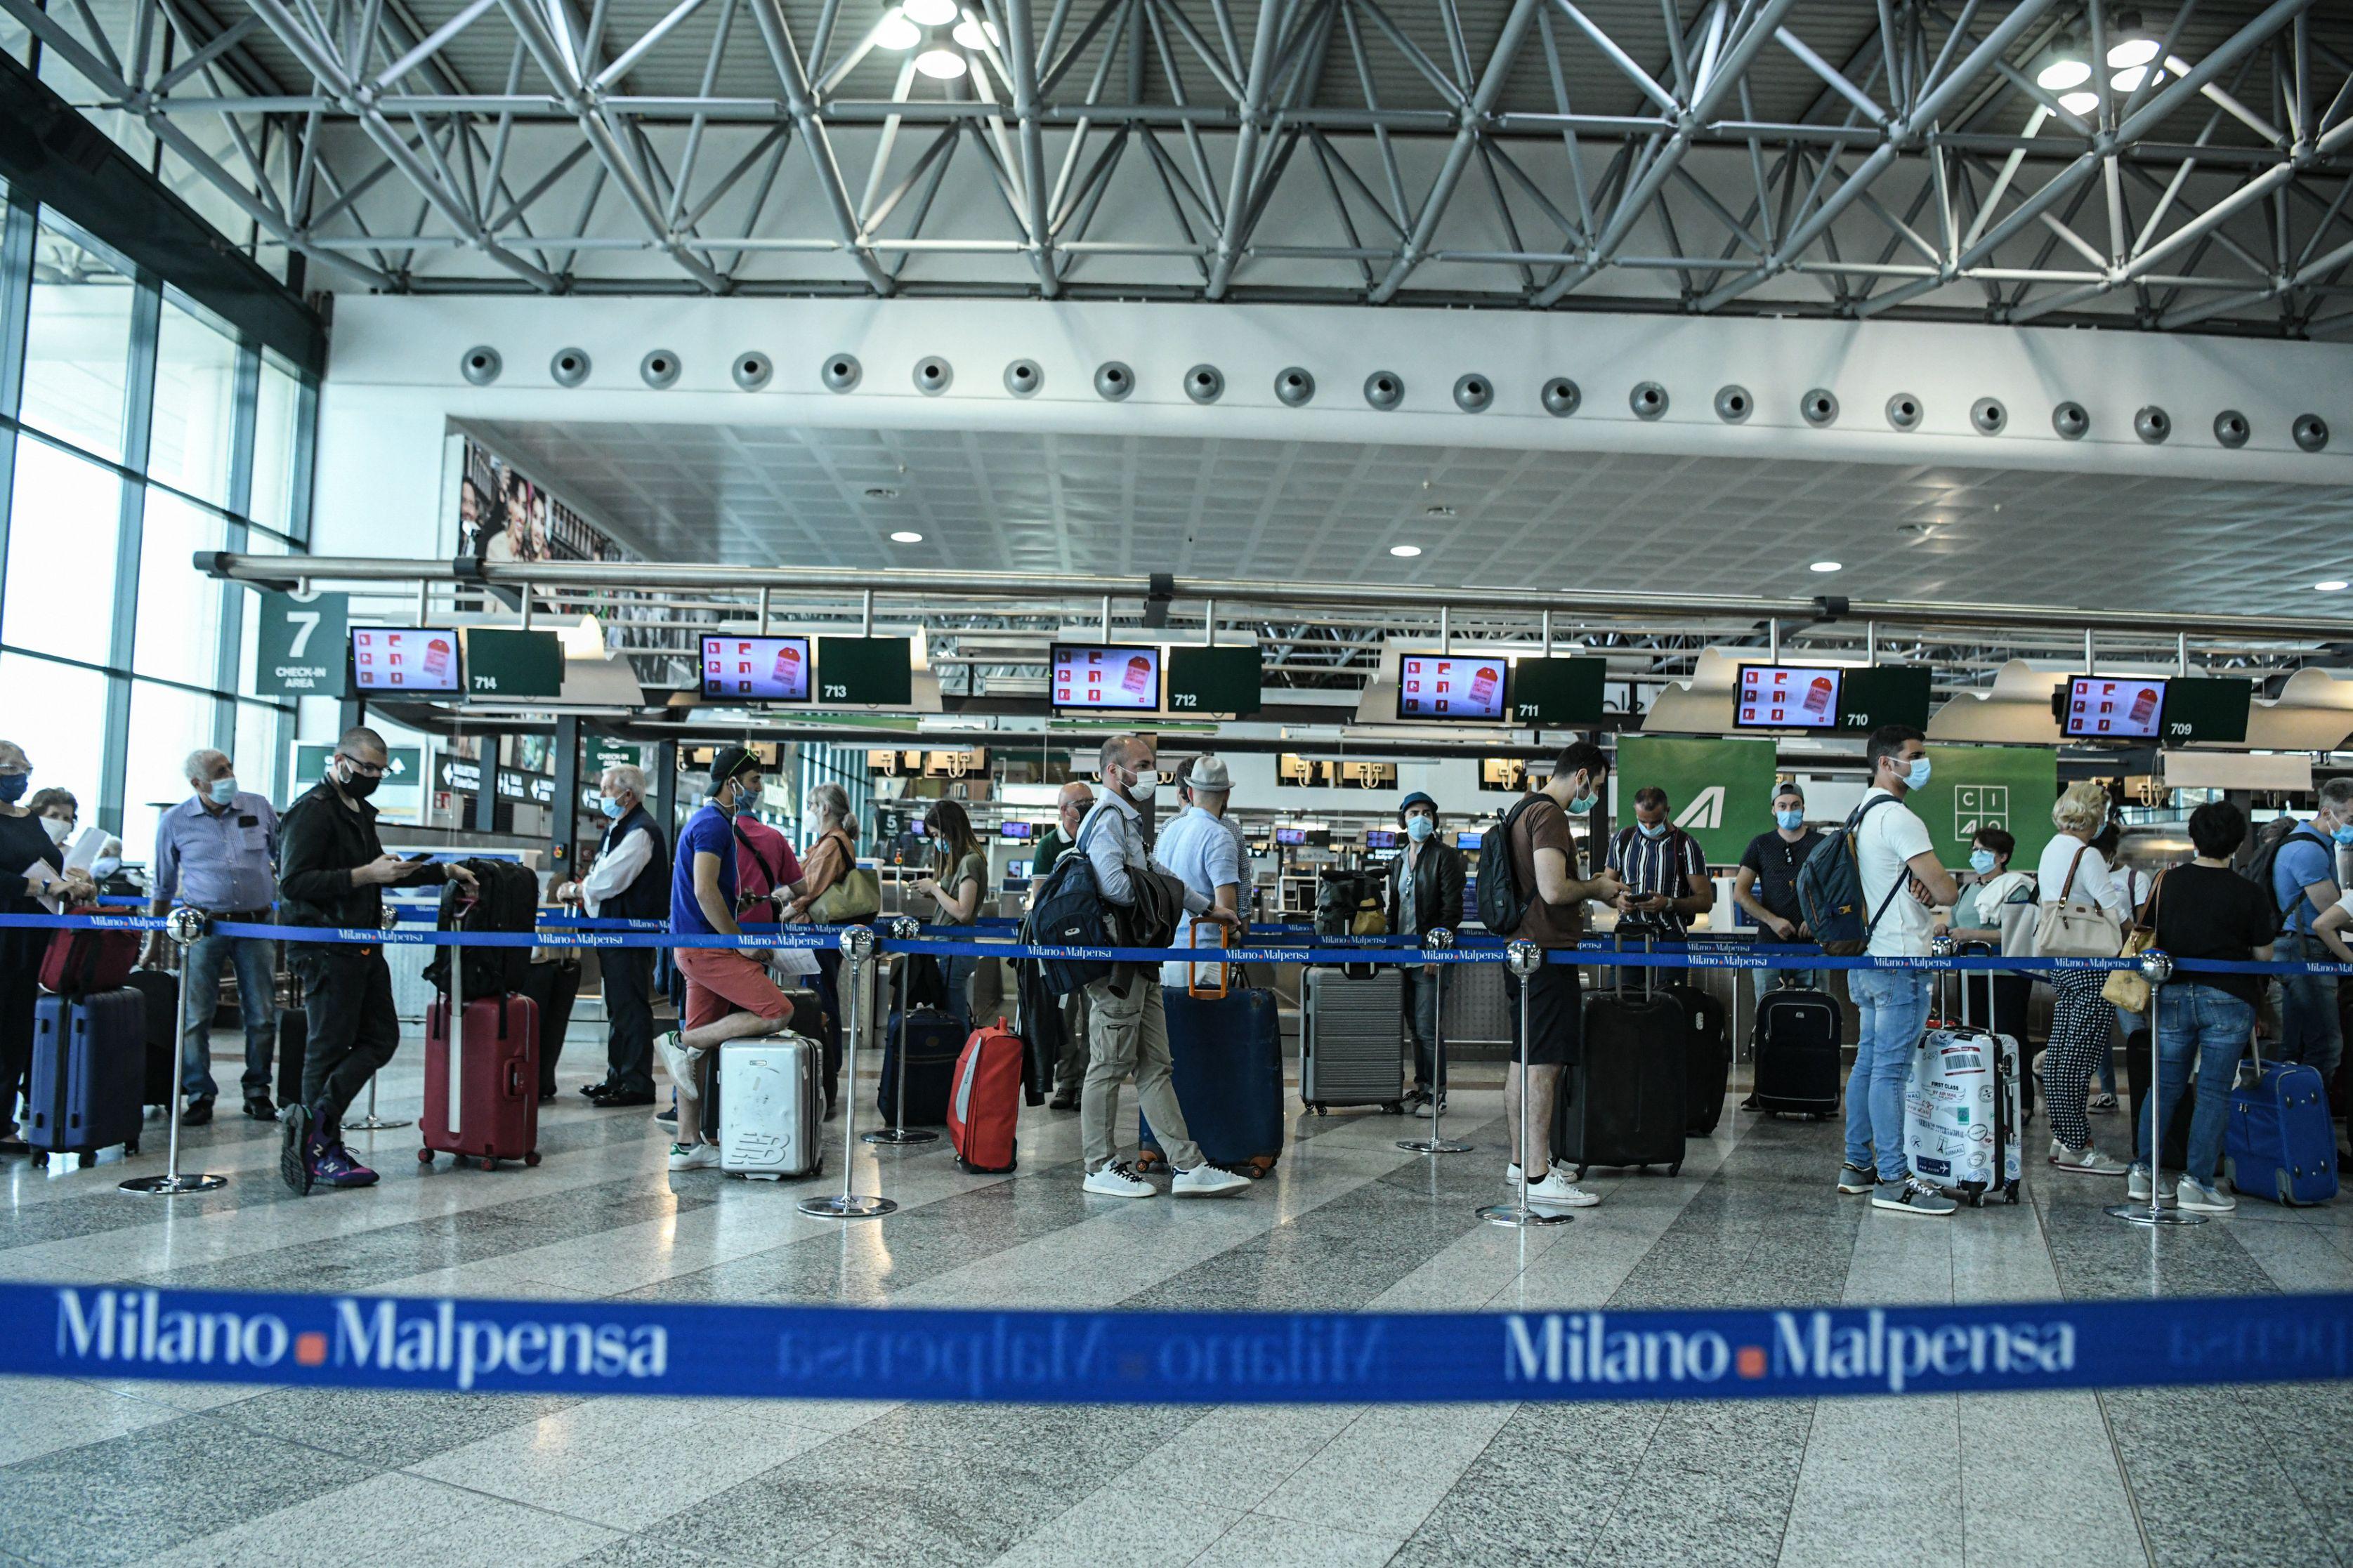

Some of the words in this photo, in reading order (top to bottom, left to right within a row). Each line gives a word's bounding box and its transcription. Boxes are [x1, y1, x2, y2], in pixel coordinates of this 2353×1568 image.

[287, 612, 321, 658] 7
[275, 667, 326, 678] CHECK-IN
[284, 678, 314, 688] AREA
[475, 676, 497, 690] 714
[825, 685, 846, 698] 713
[1174, 694, 1197, 706] 712
[1519, 704, 1538, 717] 711
[1847, 713, 1868, 726] 710
[2170, 723, 2192, 734] 709
[886, 815, 898, 829] 5
[90, 916, 124, 927] Milano
[128, 916, 167, 929] Malpens
[628, 919, 655, 928] Milano
[784, 923, 811, 932] Milano
[815, 924, 844, 935] Malpen
[338, 929, 371, 940] Milano
[376, 930, 424, 944] Malpensa
[538, 933, 570, 944] Milano
[576, 934, 623, 946] Malpensa
[738, 935, 771, 946] Milano
[776, 935, 824, 948] Malpensa
[1321, 935, 1346, 944] Milano
[1351, 936, 1387, 946] Malpensa
[1027, 945, 1059, 956] Milano
[1066, 947, 1112, 959] Malpensa
[1226, 949, 1258, 960] Milano
[1264, 949, 1309, 961] Malpensa
[1715, 944, 1750, 953] Malpensa
[1421, 949, 1453, 961] Milano
[1459, 950, 1504, 962] Malpensa
[1687, 954, 1718, 966] Milano
[1724, 956, 1767, 968] Malpensa
[1873, 957, 1903, 967] Milano
[1909, 958, 1951, 968] Malpensa
[2054, 958, 2084, 967] Milano
[2089, 958, 2130, 969] Malpensa
[2306, 963, 2333, 973] Milano
[1932, 1081, 1944, 1089] FIRST
[1945, 1083, 1959, 1091] CLASS
[55, 1289, 289, 1368] Milano
[333, 1298, 669, 1391] Malpensa
[1504, 1314, 1729, 1384] Milano
[1773, 1310, 2076, 1393] Malpensa
